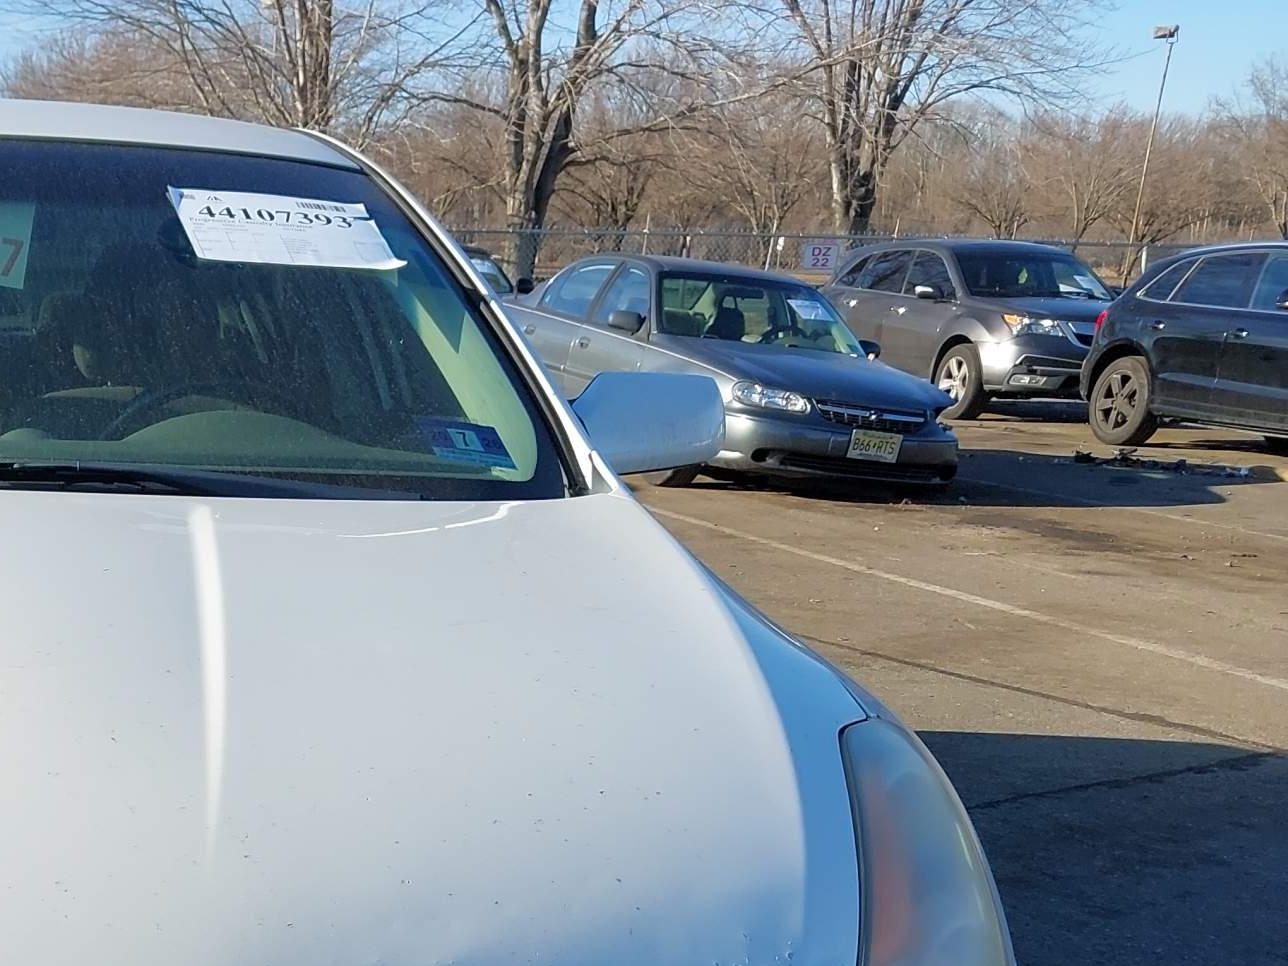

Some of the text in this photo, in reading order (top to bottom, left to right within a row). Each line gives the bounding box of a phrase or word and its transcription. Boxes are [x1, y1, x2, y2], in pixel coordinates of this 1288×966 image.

[198, 205, 353, 229] 44107393
[812, 246, 832, 257] DZ
[811, 257, 829, 267] 22
